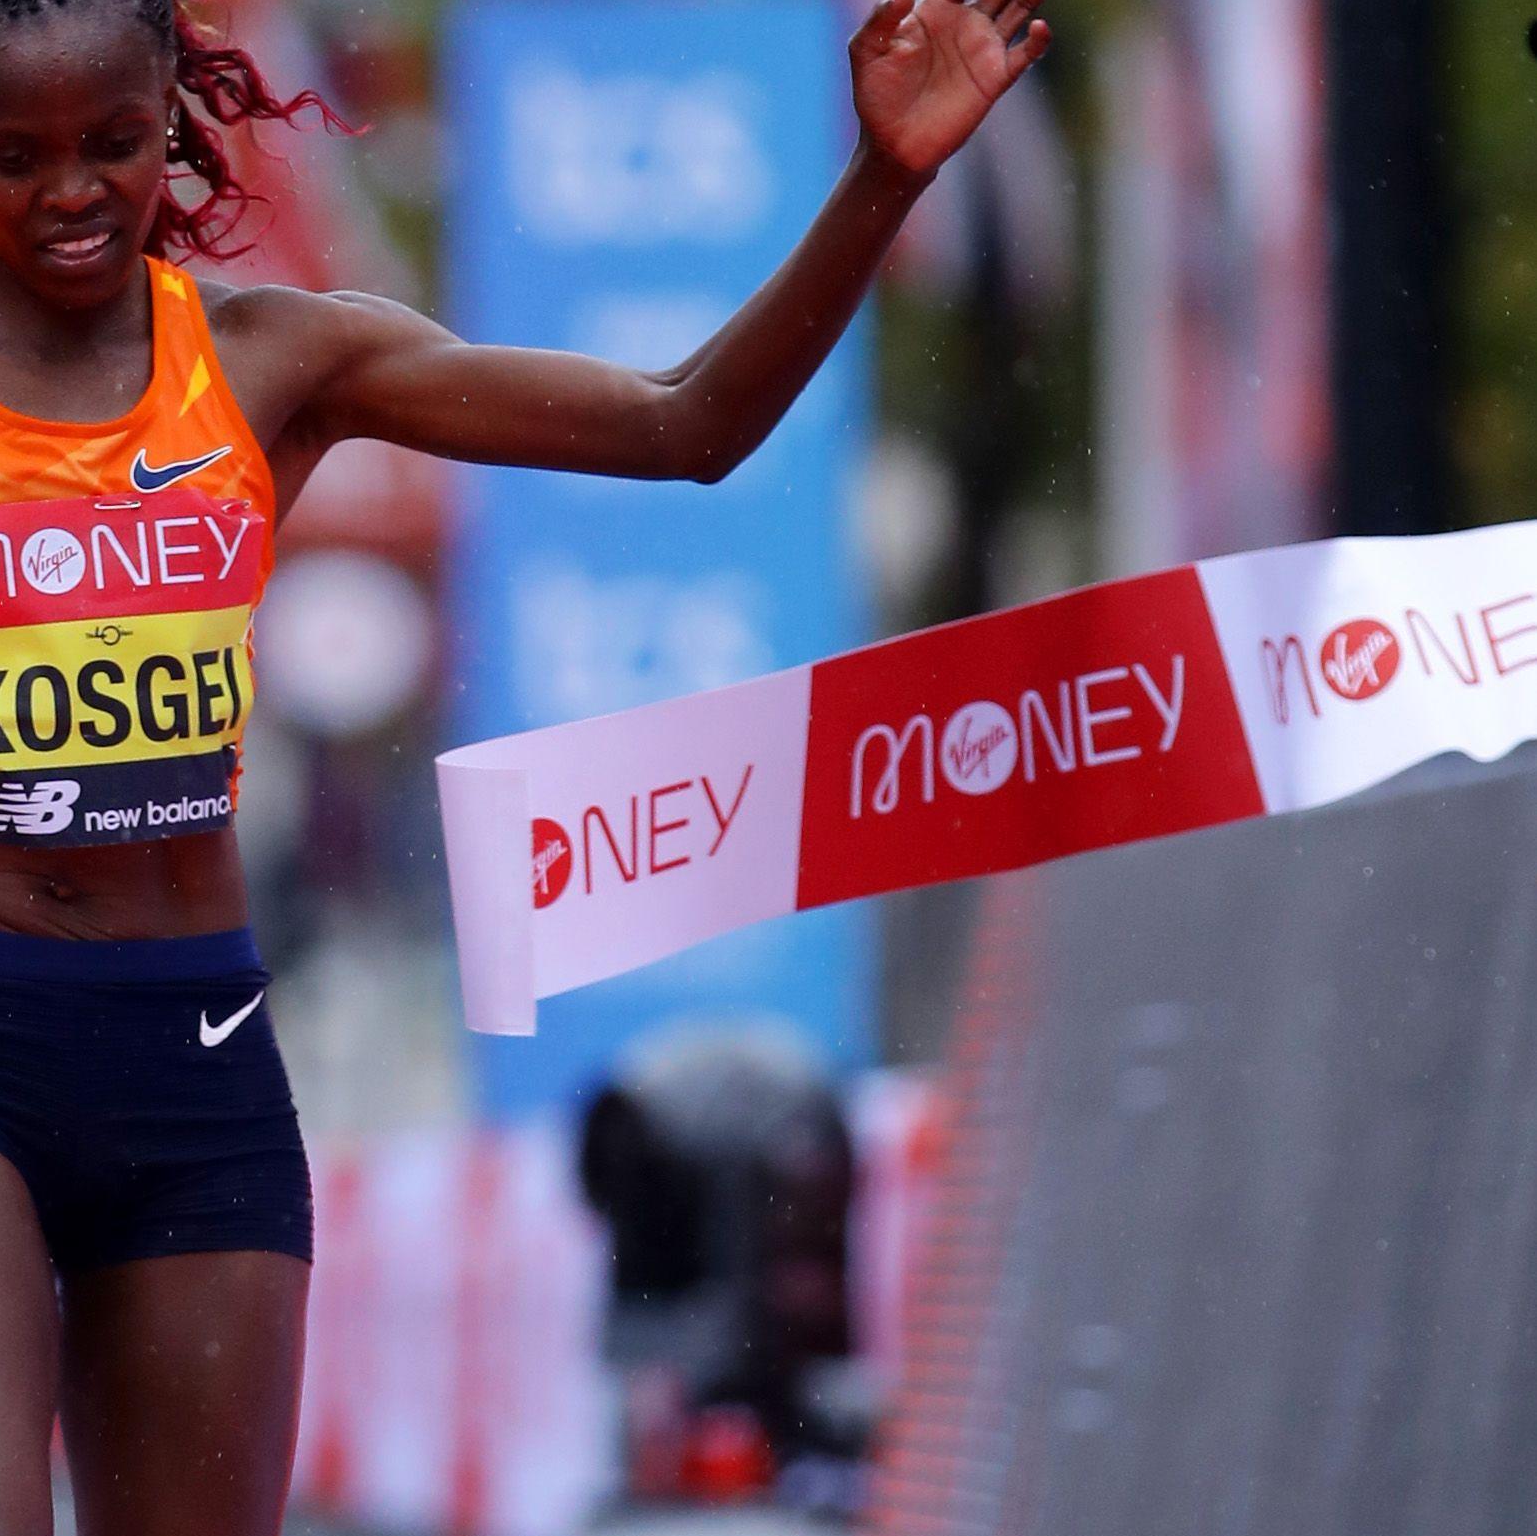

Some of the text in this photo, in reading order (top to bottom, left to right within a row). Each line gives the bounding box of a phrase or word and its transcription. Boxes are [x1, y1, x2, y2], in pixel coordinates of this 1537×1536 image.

[27, 538, 79, 584] Virgin
[1261, 594, 1537, 725] MONE
[950, 715, 1010, 779] Virgin
[84, 806, 142, 832] new
[147, 794, 232, 826] balanc
[532, 763, 754, 909] ONEY
